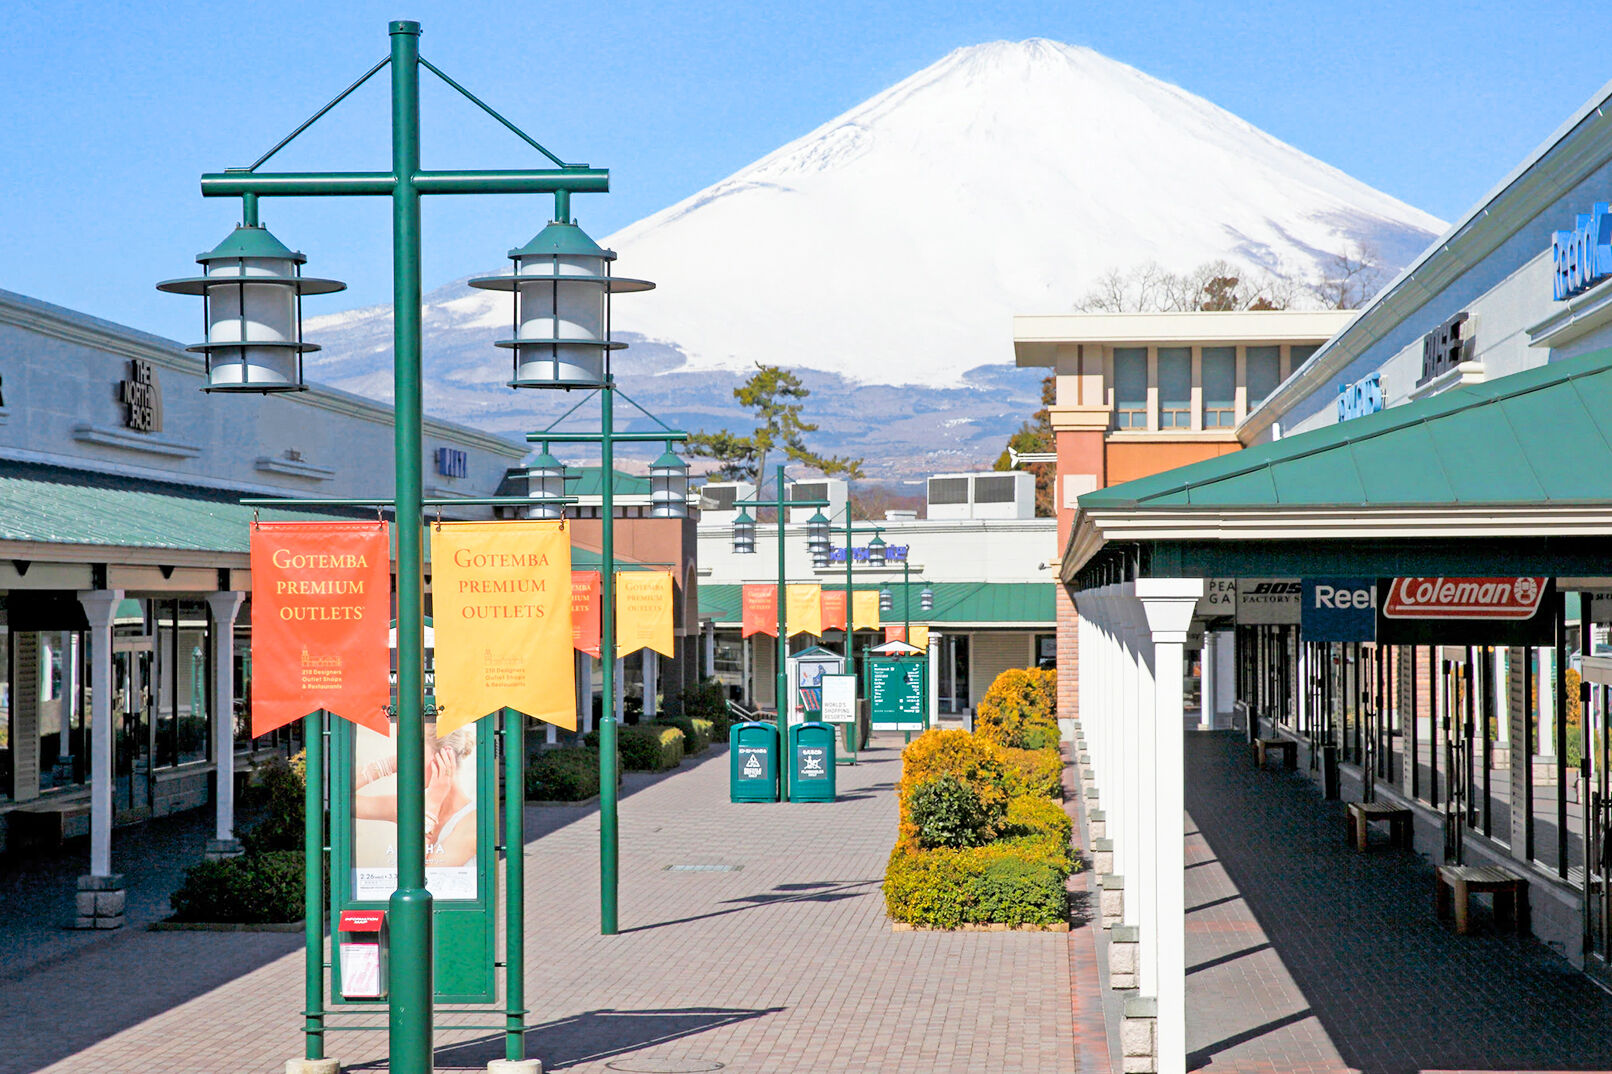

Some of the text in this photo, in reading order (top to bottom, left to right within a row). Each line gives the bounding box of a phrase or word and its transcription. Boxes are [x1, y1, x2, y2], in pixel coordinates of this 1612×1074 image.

[132, 359, 151, 384] THE
[122, 380, 153, 409] NORTH
[129, 404, 153, 432] FACE
[272, 548, 369, 569] GOTEMBA
[454, 548, 550, 568] GOTEMBA
[276, 580, 365, 595] PREMIUM
[458, 579, 546, 593] PREMIUM
[1209, 581, 1236, 591] PEA
[1242, 582, 1302, 594] BOS
[1399, 577, 1513, 604] Coleman
[1209, 593, 1231, 604] GA
[1243, 595, 1290, 603] FACTORY
[1315, 585, 1376, 609] Ree
[280, 606, 363, 620] OUTLETS
[462, 604, 545, 619] OUTLETS
